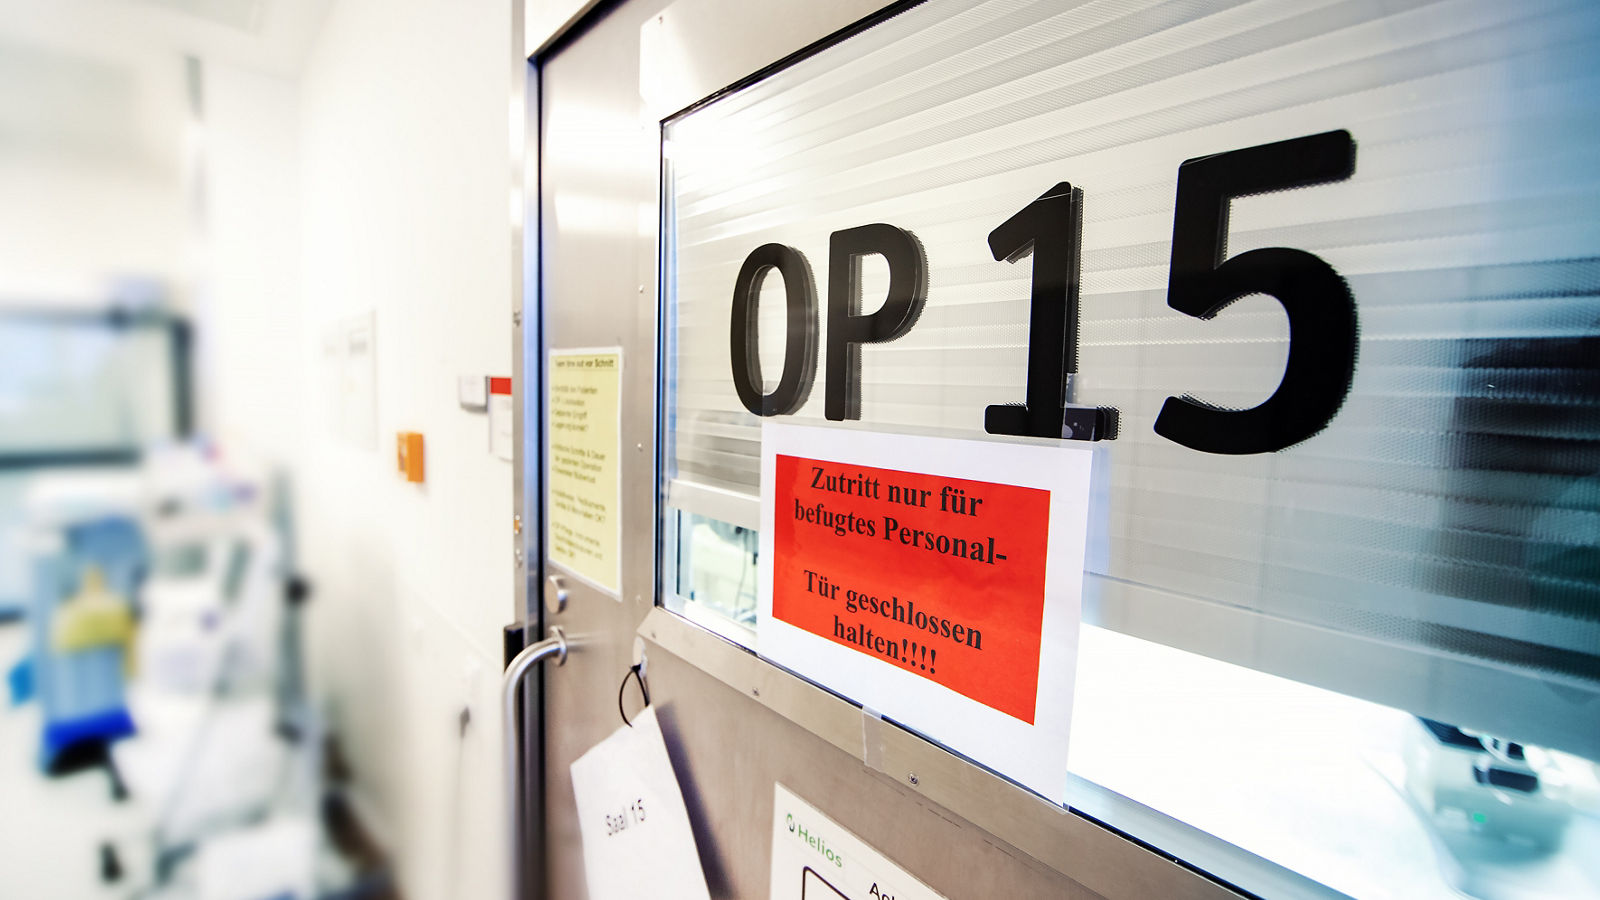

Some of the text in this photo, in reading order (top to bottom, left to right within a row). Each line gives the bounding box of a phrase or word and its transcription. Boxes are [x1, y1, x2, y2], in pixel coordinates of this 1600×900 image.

[730, 128, 1360, 455] OP 15
[810, 466, 983, 517] Zutritt nur für
[794, 498, 1008, 565] befugtes Personal-
[804, 569, 983, 650] Tür geschlossen
[833, 615, 937, 675] halten!!!!
[605, 798, 647, 837] Saal 15
[798, 824, 842, 868] Helios
